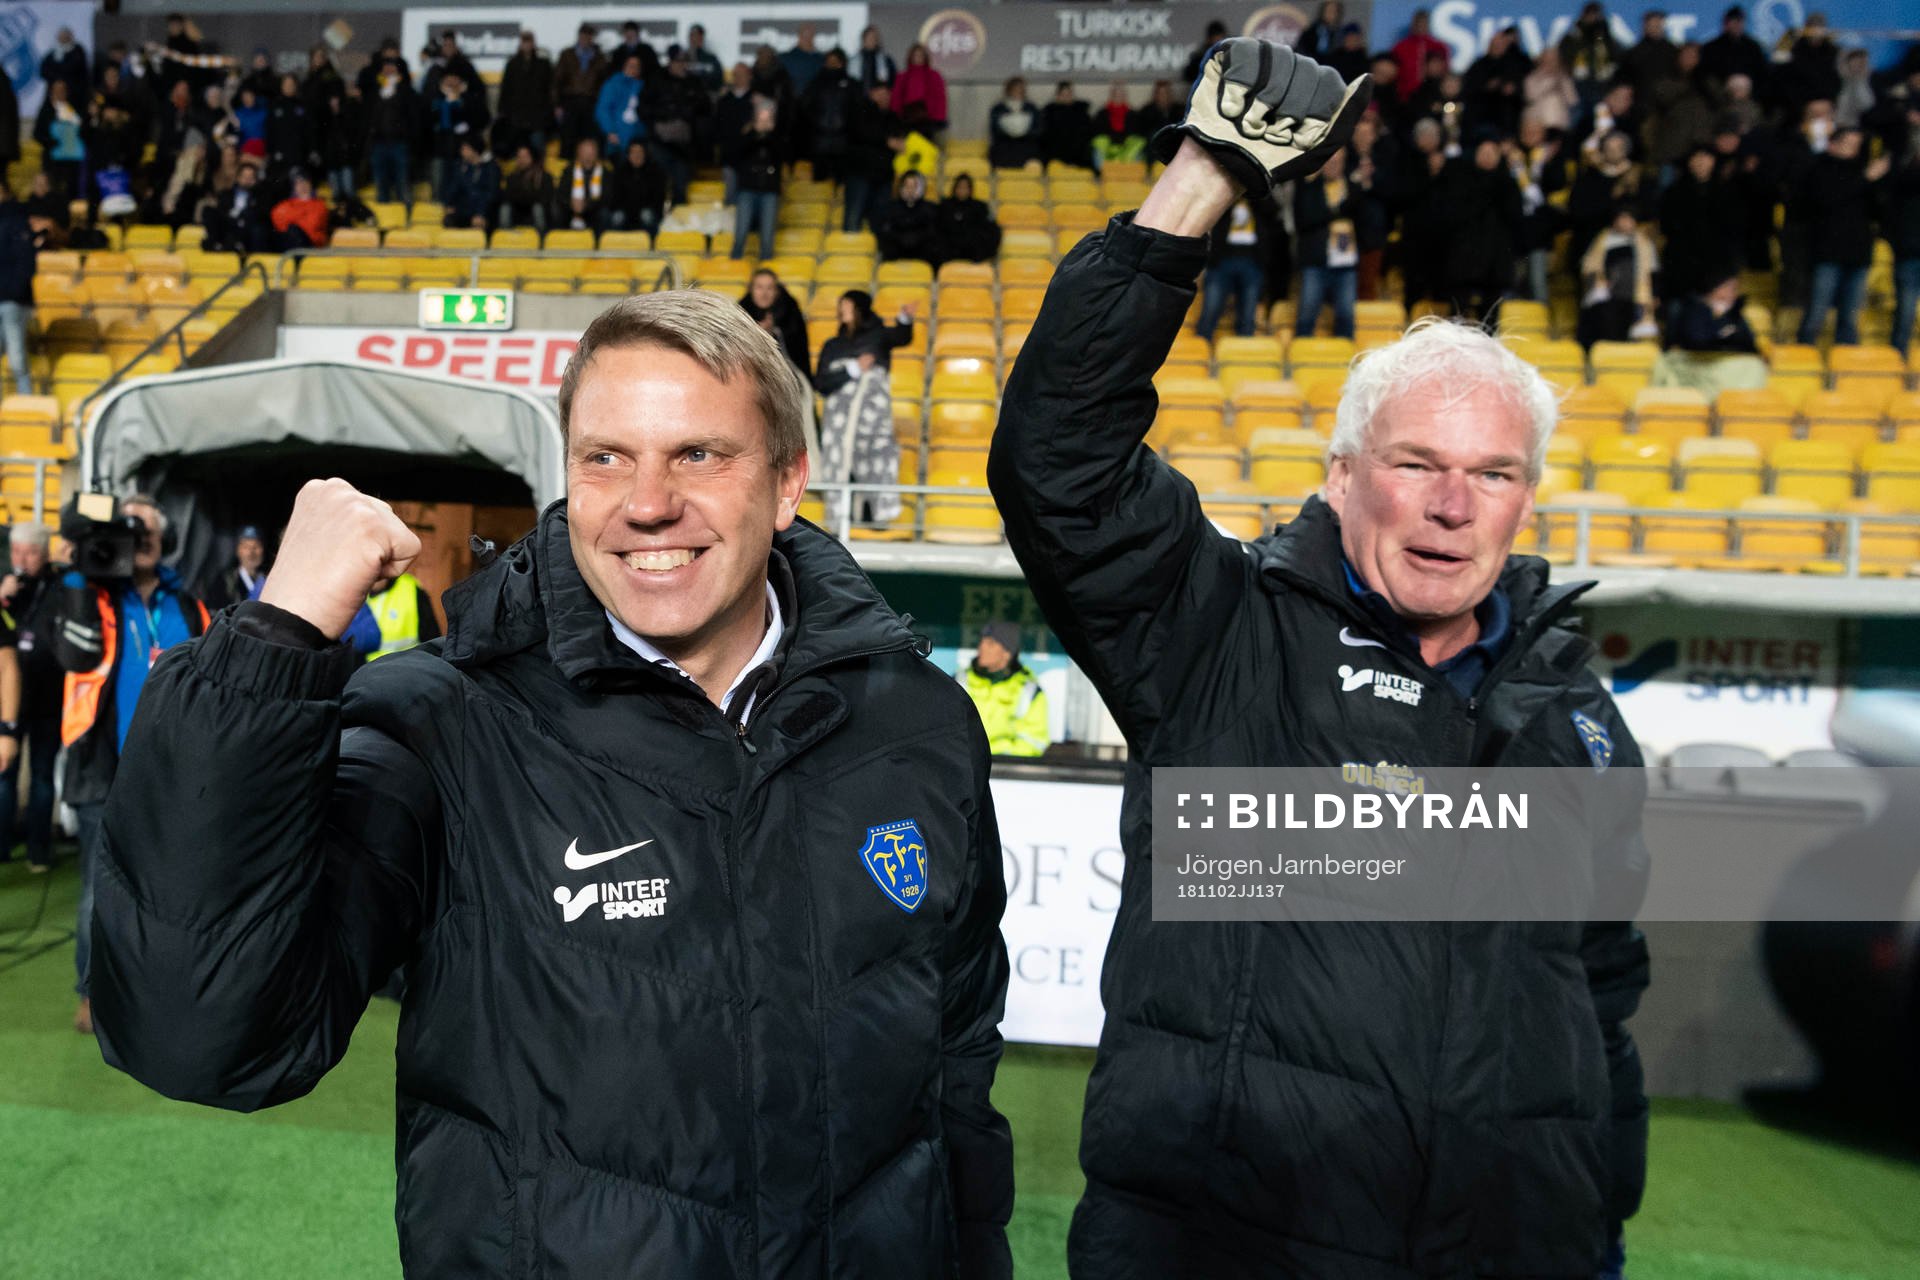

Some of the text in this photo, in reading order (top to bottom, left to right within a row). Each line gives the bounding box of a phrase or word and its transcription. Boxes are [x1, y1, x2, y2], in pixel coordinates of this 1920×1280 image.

[1056, 9, 1173, 38] TURKISK
[1688, 637, 1821, 669] INTER
[1375, 671, 1422, 695] INTER
[1685, 671, 1815, 704] SPORT
[1374, 685, 1421, 706] SPORT
[601, 878, 668, 902] INTER
[901, 884, 920, 898] 1928
[602, 897, 668, 920] SPORT
[1006, 943, 1083, 986] CE
